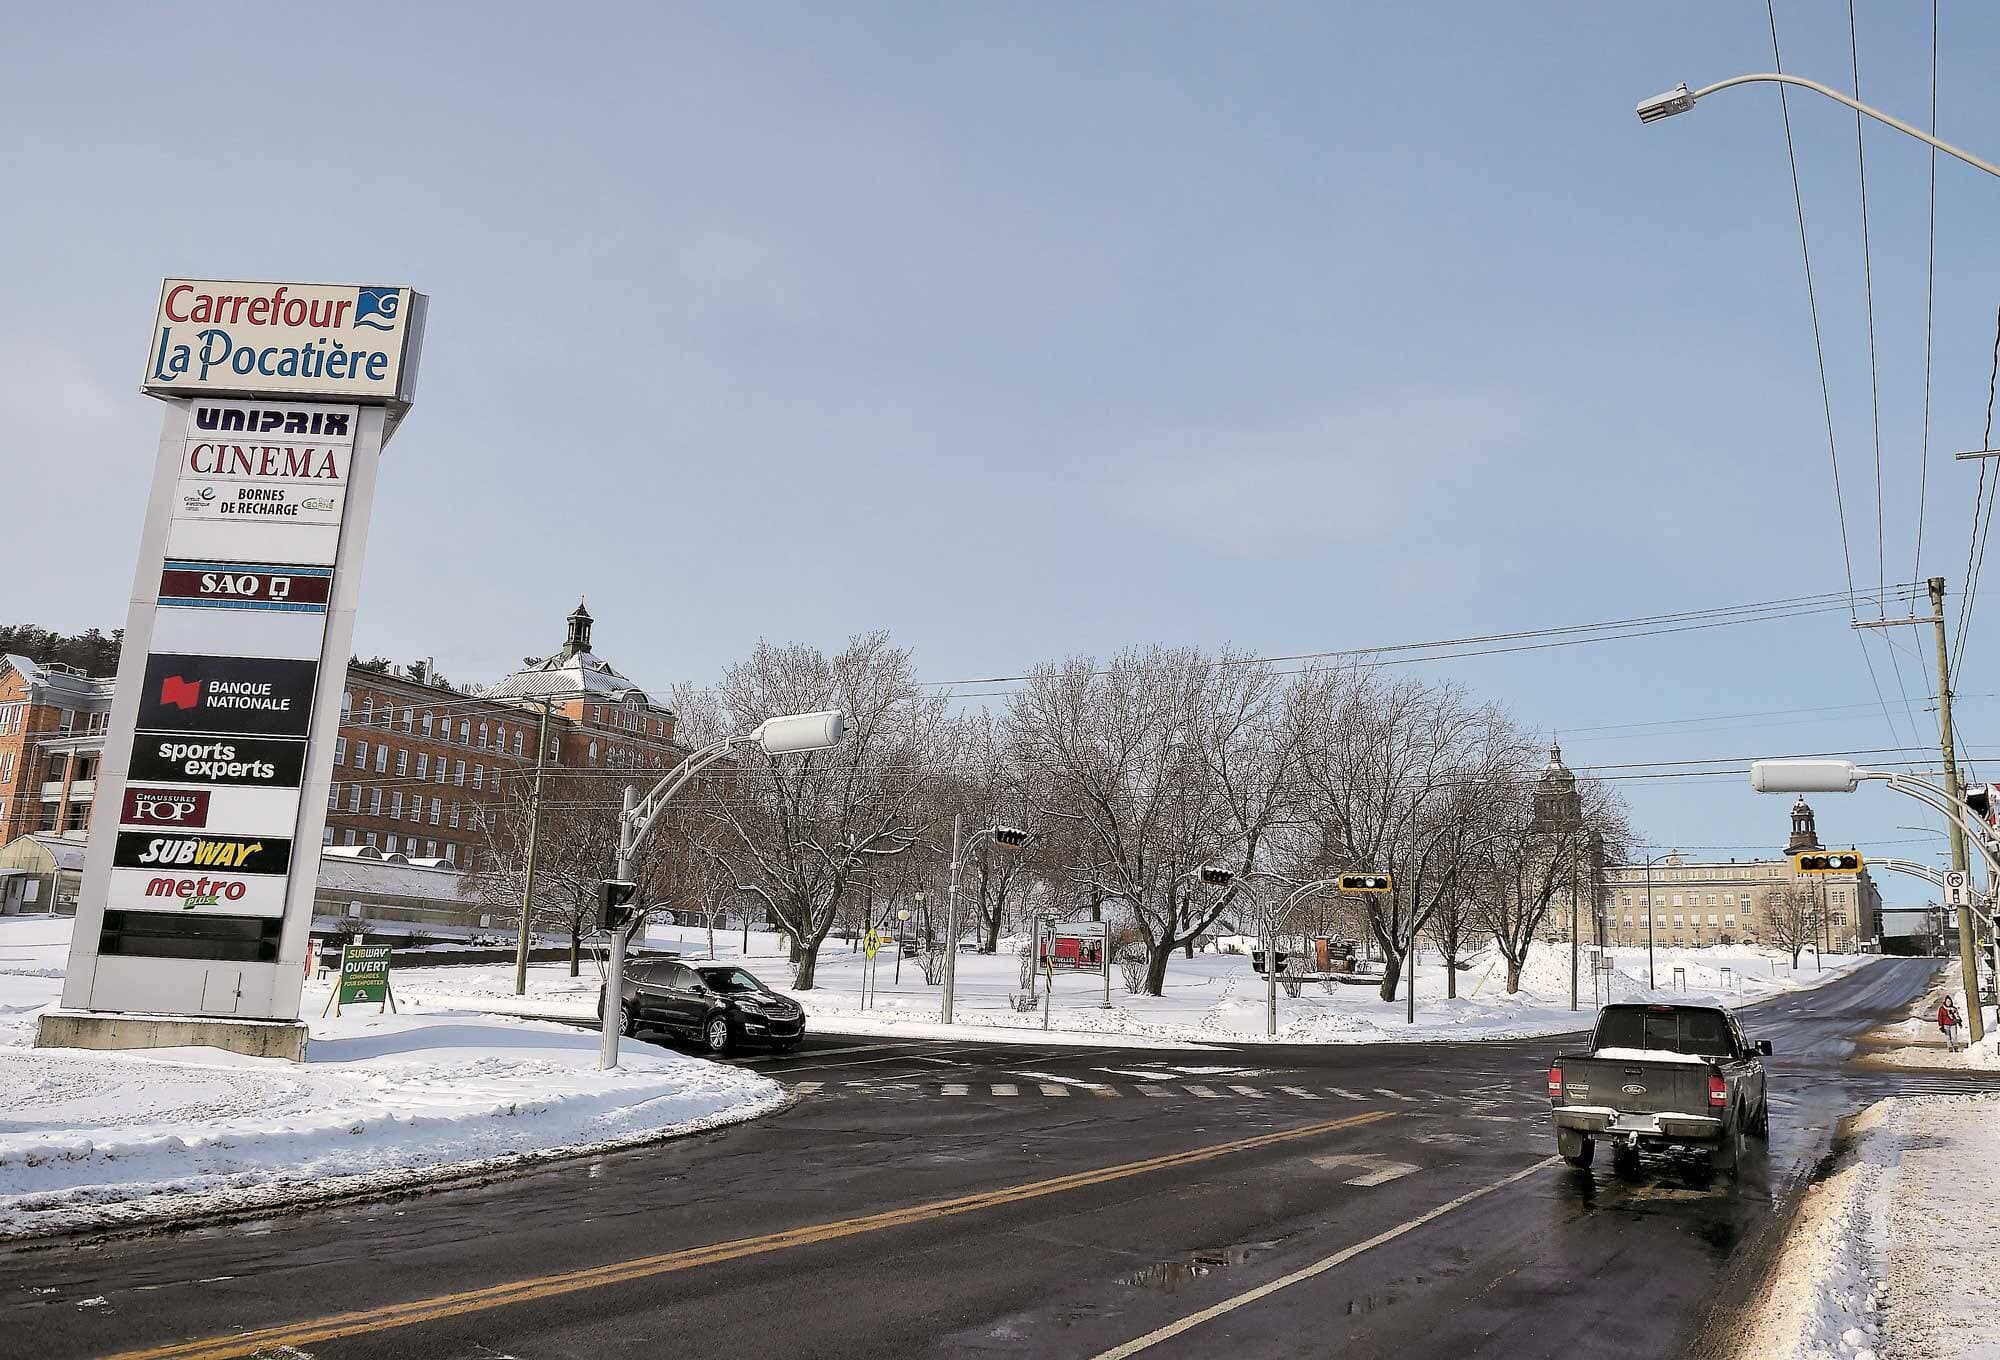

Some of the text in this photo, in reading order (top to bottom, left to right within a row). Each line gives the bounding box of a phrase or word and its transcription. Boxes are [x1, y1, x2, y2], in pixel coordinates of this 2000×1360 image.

[164, 284, 352, 329] Carrefour
[152, 326, 389, 382] La Pocatière
[196, 407, 350, 436] UNIPRIX
[190, 443, 340, 479] CINEMA
[238, 488, 285, 501] BORNES
[220, 502, 236, 514] DE
[237, 502, 299, 516] RECHARGE
[200, 573, 260, 597] SAQ
[208, 681, 273, 696] BANQUE
[206, 696, 291, 711] NATIONALE
[158, 742, 236, 762] sports
[184, 759, 275, 780] experts
[136, 793, 197, 804] CHAUSSURES
[132, 800, 196, 821] POP
[138, 837, 263, 867] SUBWAY
[145, 877, 247, 901] metro
[187, 896, 213, 907] PLUS
[348, 948, 389, 958] SUBWAY
[345, 961, 389, 973] OUVERT
